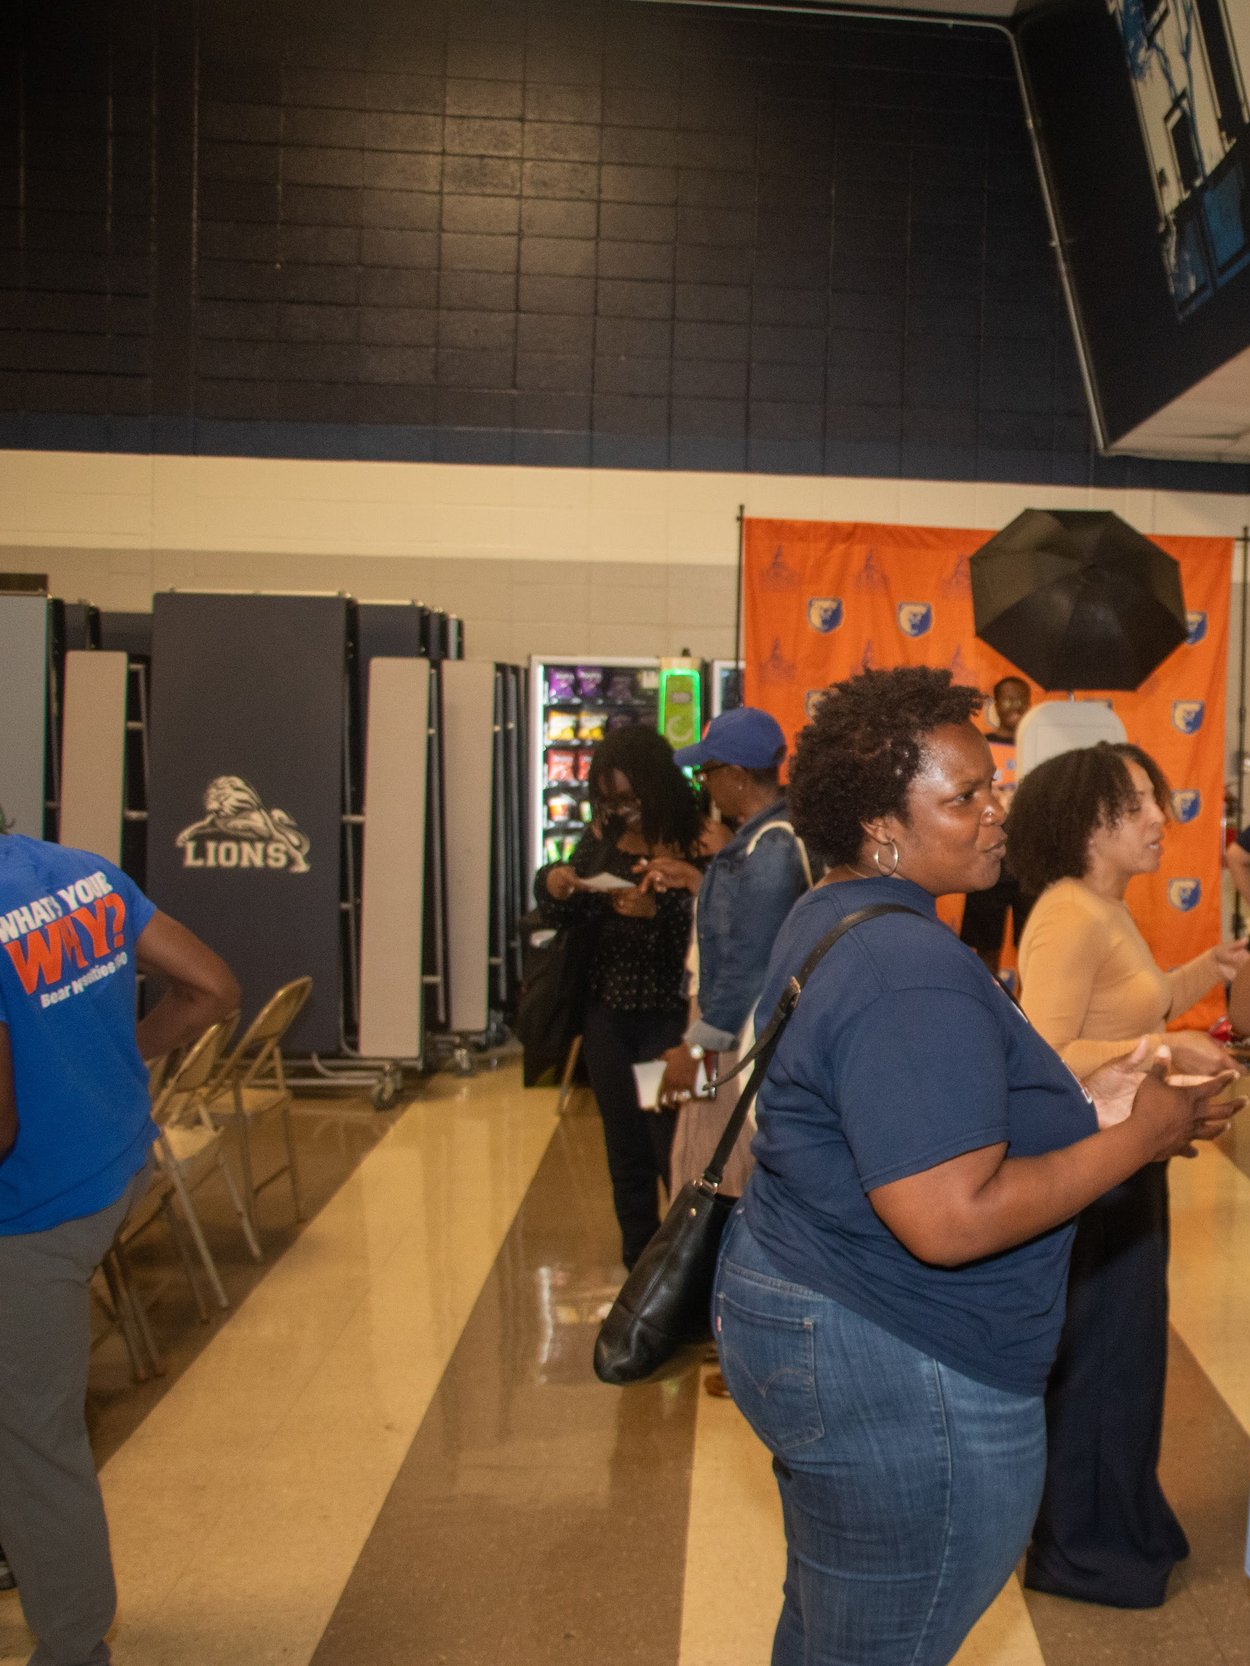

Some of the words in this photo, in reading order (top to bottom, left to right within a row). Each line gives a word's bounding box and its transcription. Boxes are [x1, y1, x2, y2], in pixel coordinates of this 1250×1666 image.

[183, 841, 288, 869] LIONS
[57, 871, 113, 911] YOUR
[4, 893, 126, 995] WHY?
[40, 985, 71, 1009] Bear
